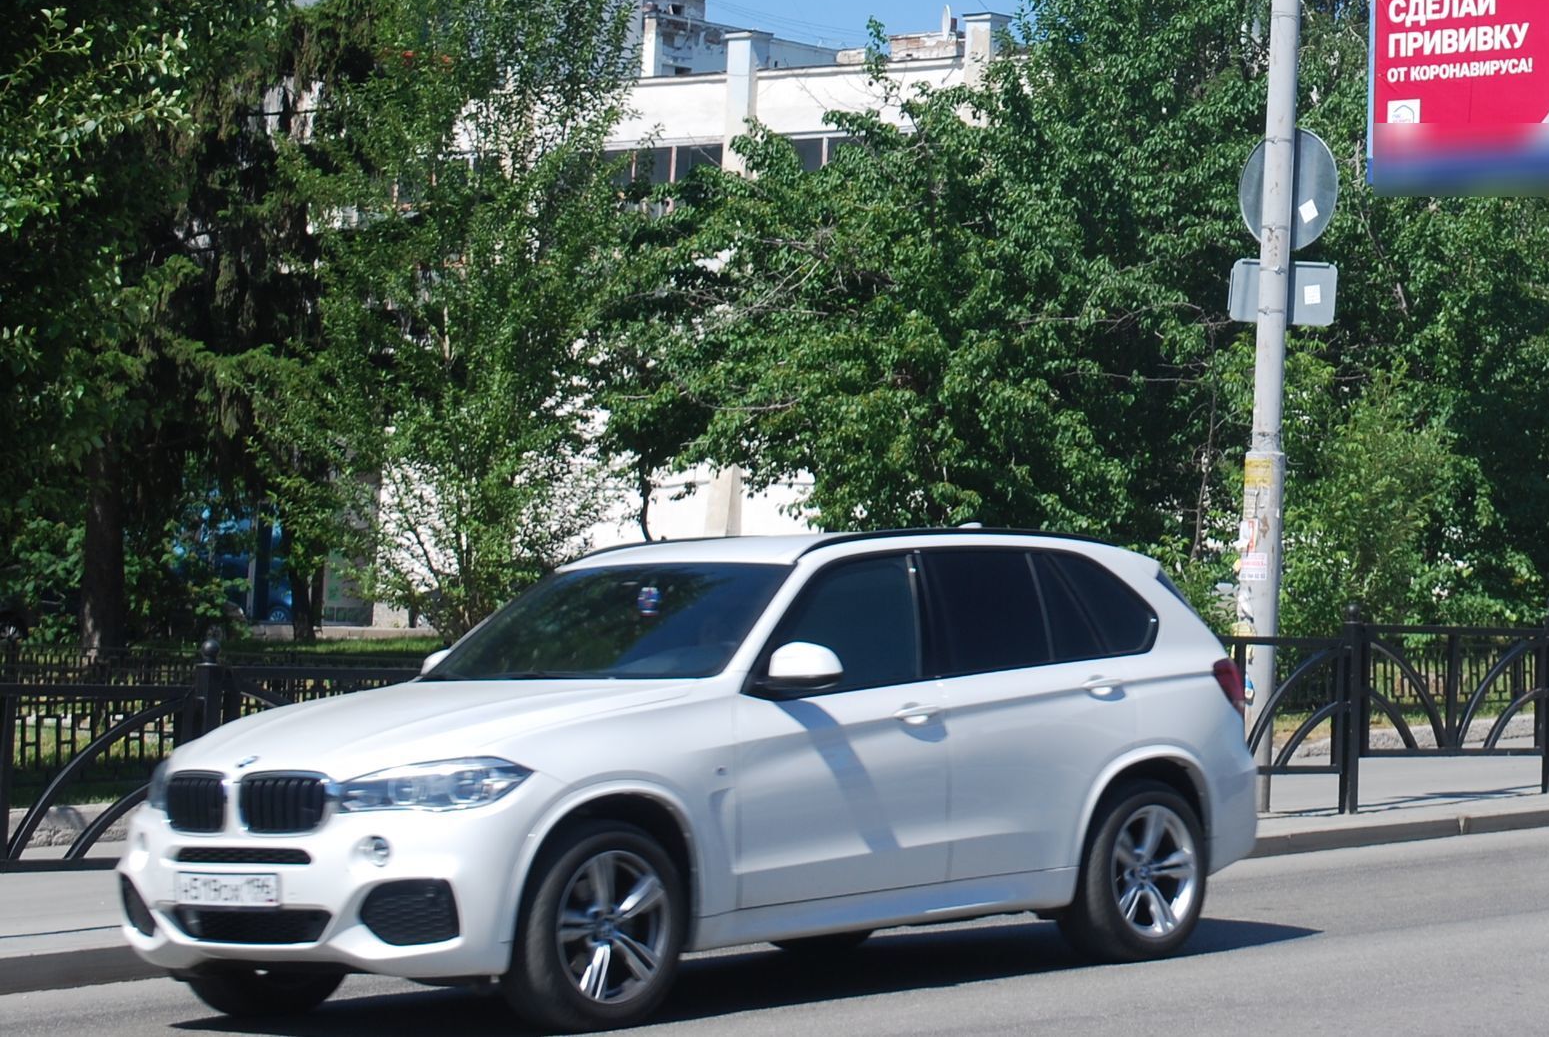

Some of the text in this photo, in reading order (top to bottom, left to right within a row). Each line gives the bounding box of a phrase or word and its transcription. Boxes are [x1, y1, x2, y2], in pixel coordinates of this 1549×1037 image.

[1388, 22, 1530, 58] ПРИВИВКУ
[1387, 57, 1533, 83] ОТ КОРОНАВИРУСА!
